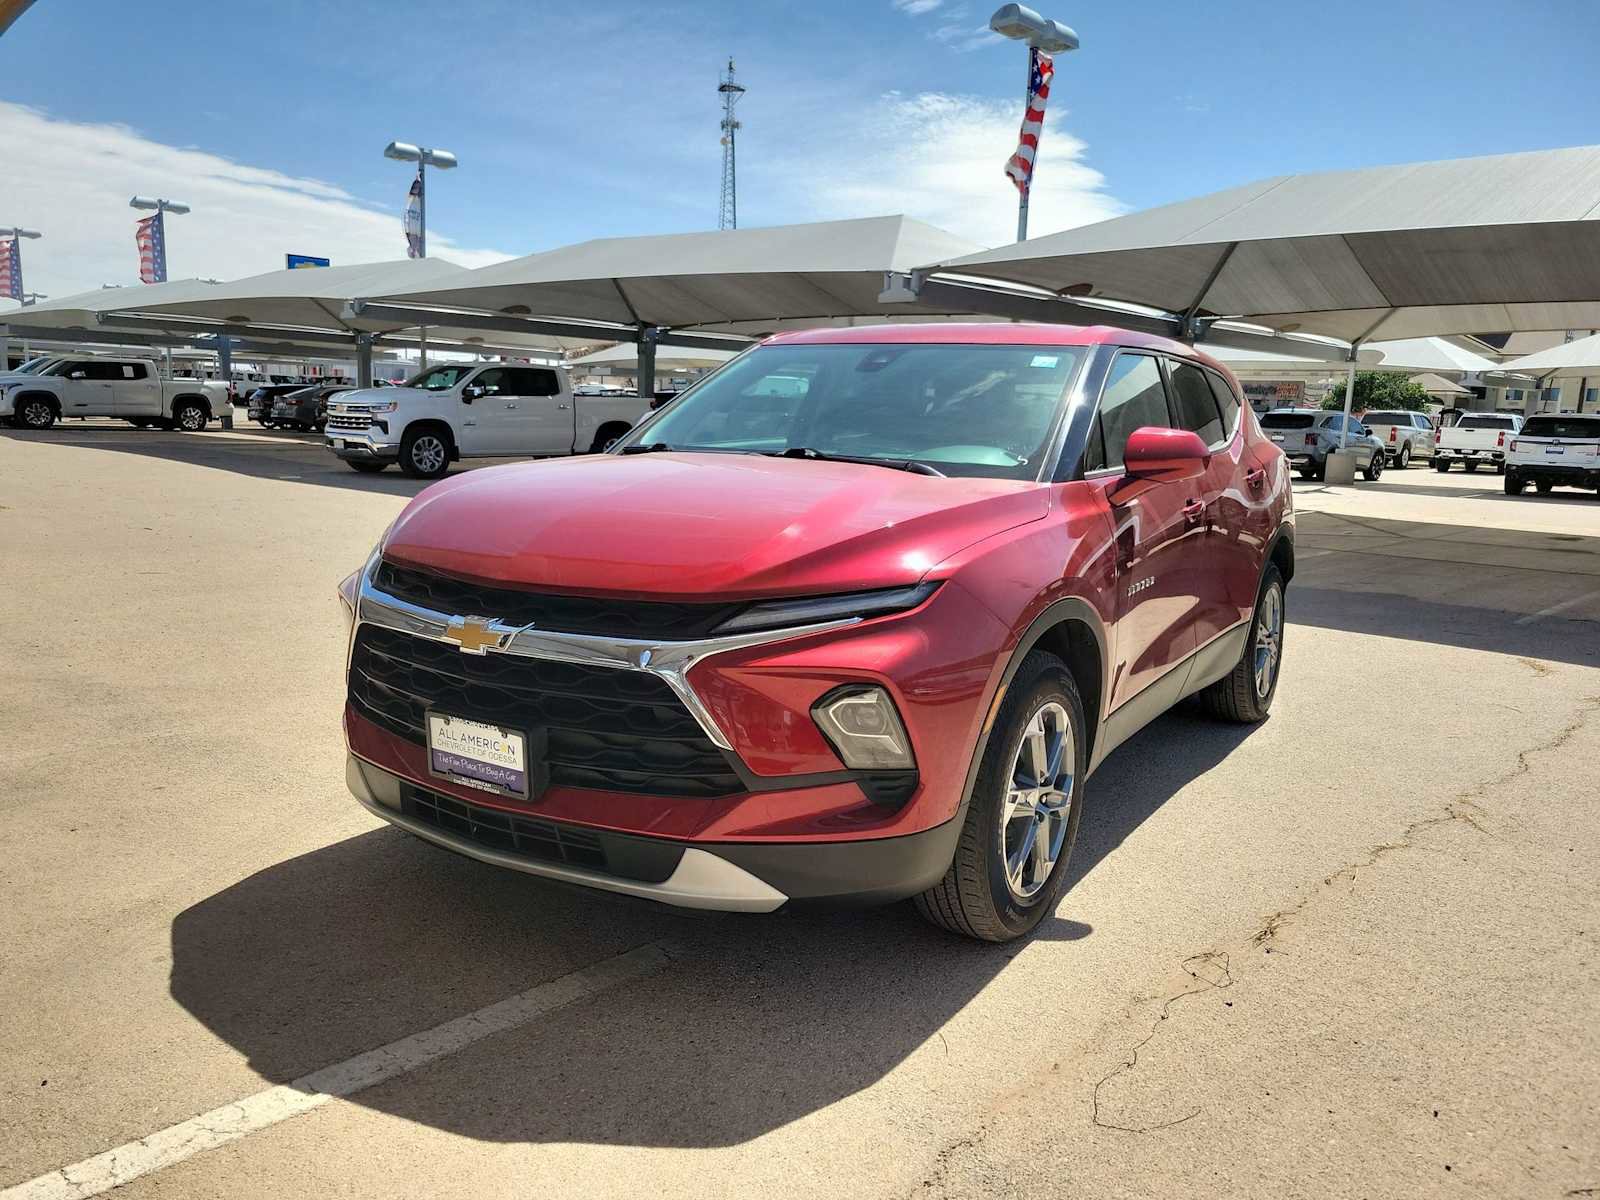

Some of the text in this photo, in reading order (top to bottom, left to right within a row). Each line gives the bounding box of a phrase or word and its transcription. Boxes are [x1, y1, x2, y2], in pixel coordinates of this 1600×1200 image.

[437, 739, 477, 756] CHEVROLET
[488, 752, 517, 766] ODESSA
[438, 728, 515, 756] ALL AMERICN
